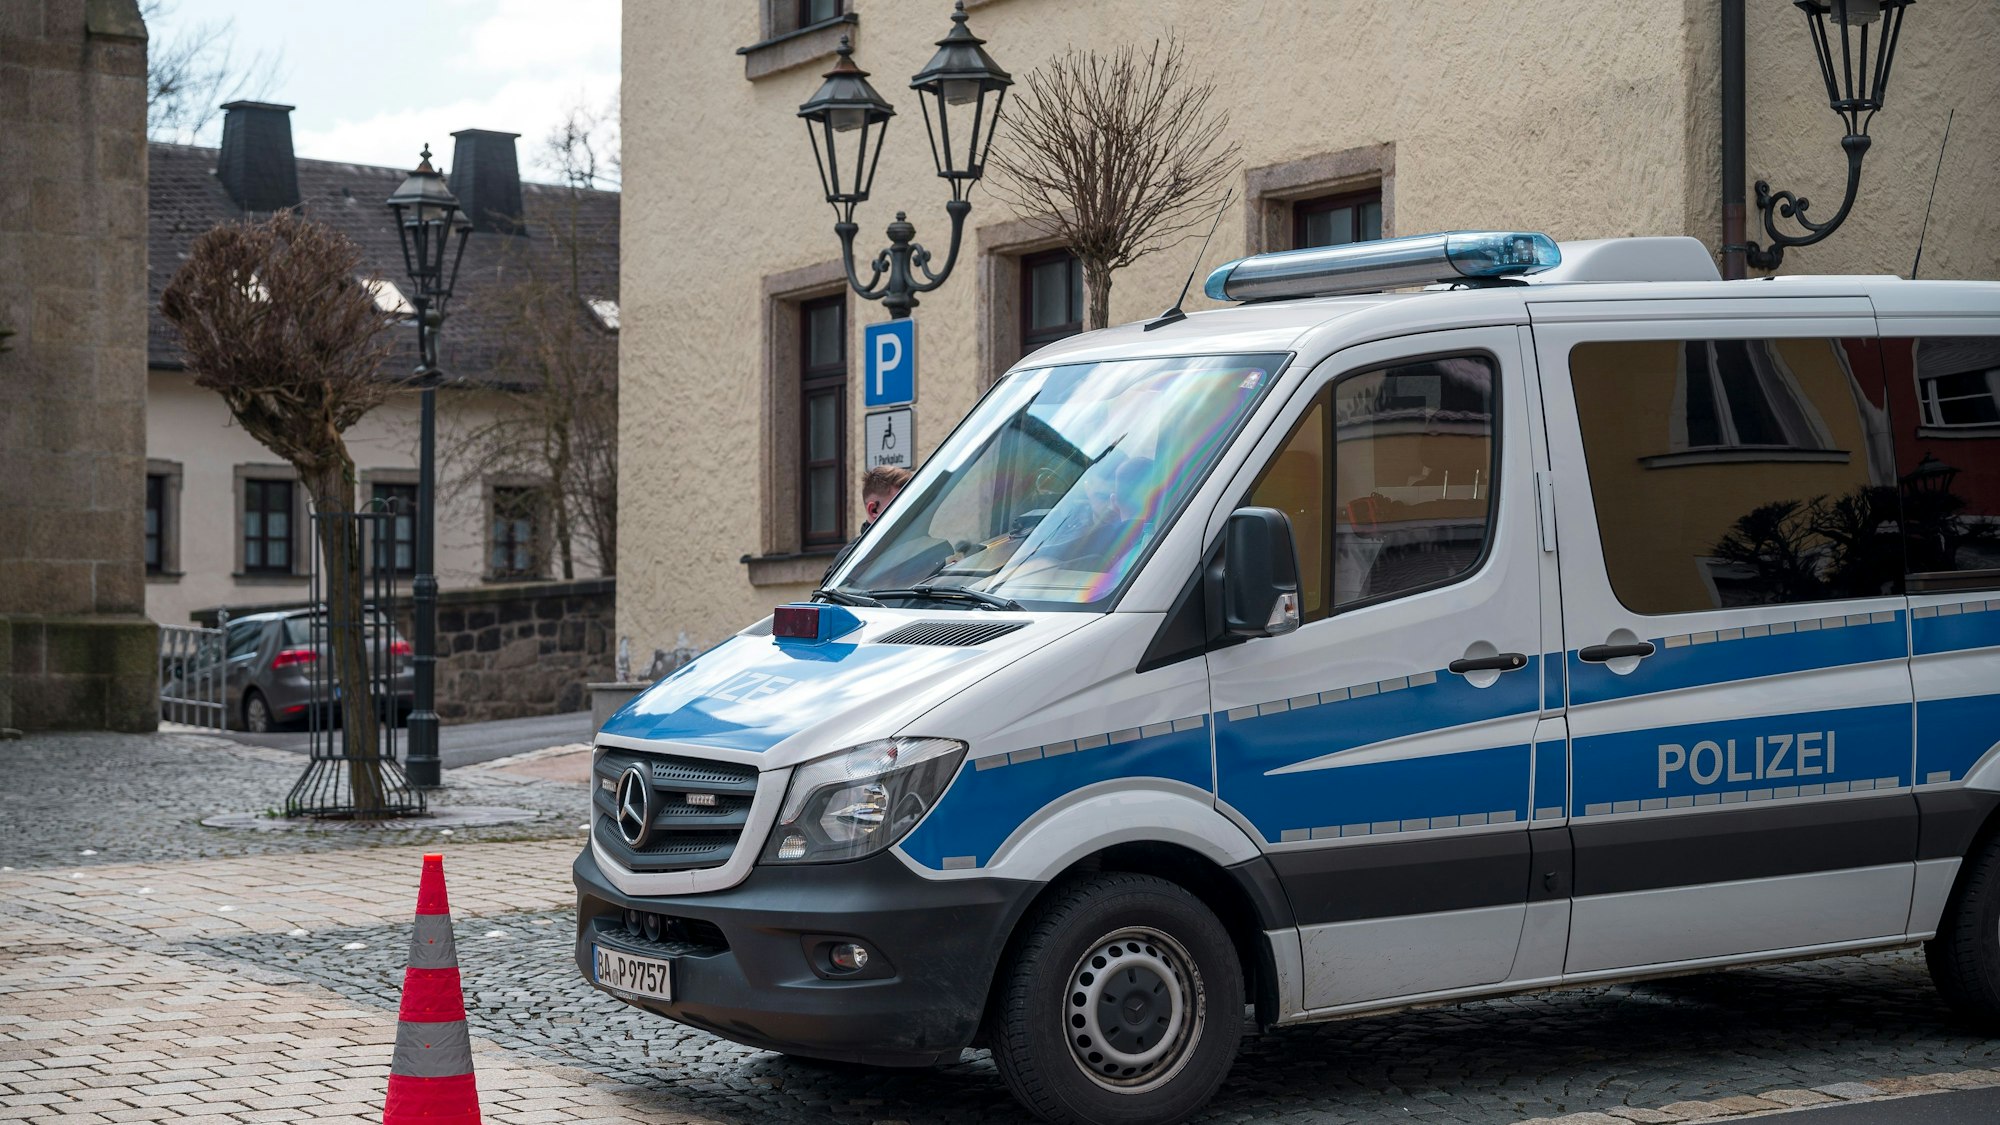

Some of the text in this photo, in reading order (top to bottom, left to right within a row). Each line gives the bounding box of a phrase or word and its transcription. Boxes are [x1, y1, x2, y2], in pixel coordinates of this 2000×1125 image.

[876, 333, 902, 395] P
[879, 453, 904, 465] Parkplatz
[1658, 731, 1835, 788] POLIZEI
[598, 951, 667, 993] BA P 9757
